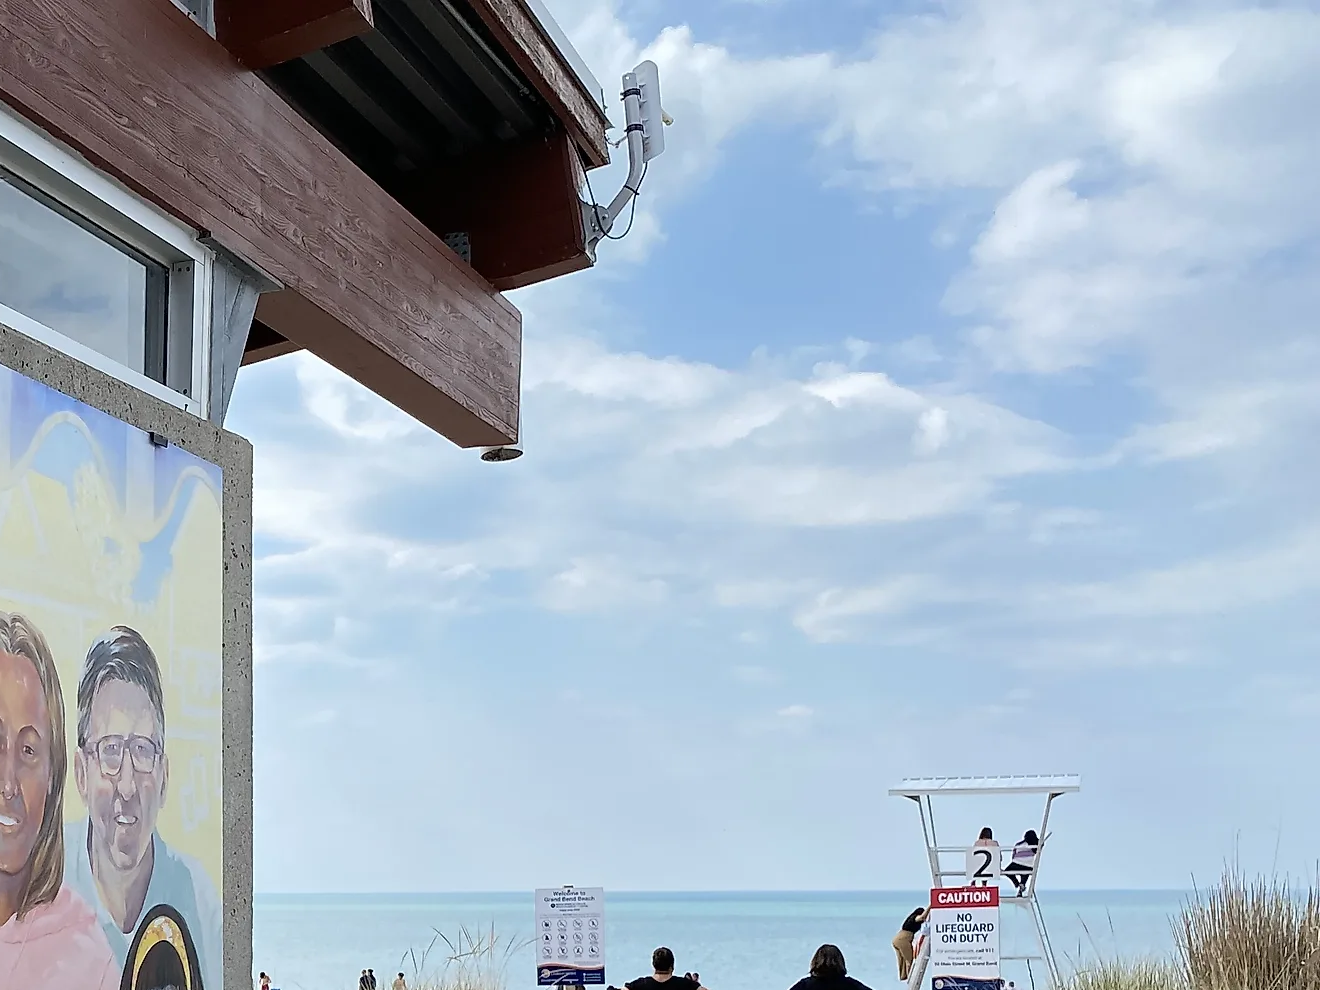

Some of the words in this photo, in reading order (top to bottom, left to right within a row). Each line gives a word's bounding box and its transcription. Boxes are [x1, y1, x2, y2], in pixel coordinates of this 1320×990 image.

[973, 850, 993, 878] 2
[938, 891, 990, 903] CAUTION
[957, 913, 972, 922] NO
[936, 923, 994, 933] LIFEGUARD
[942, 934, 956, 943] ON
[960, 934, 988, 942] DUTY
